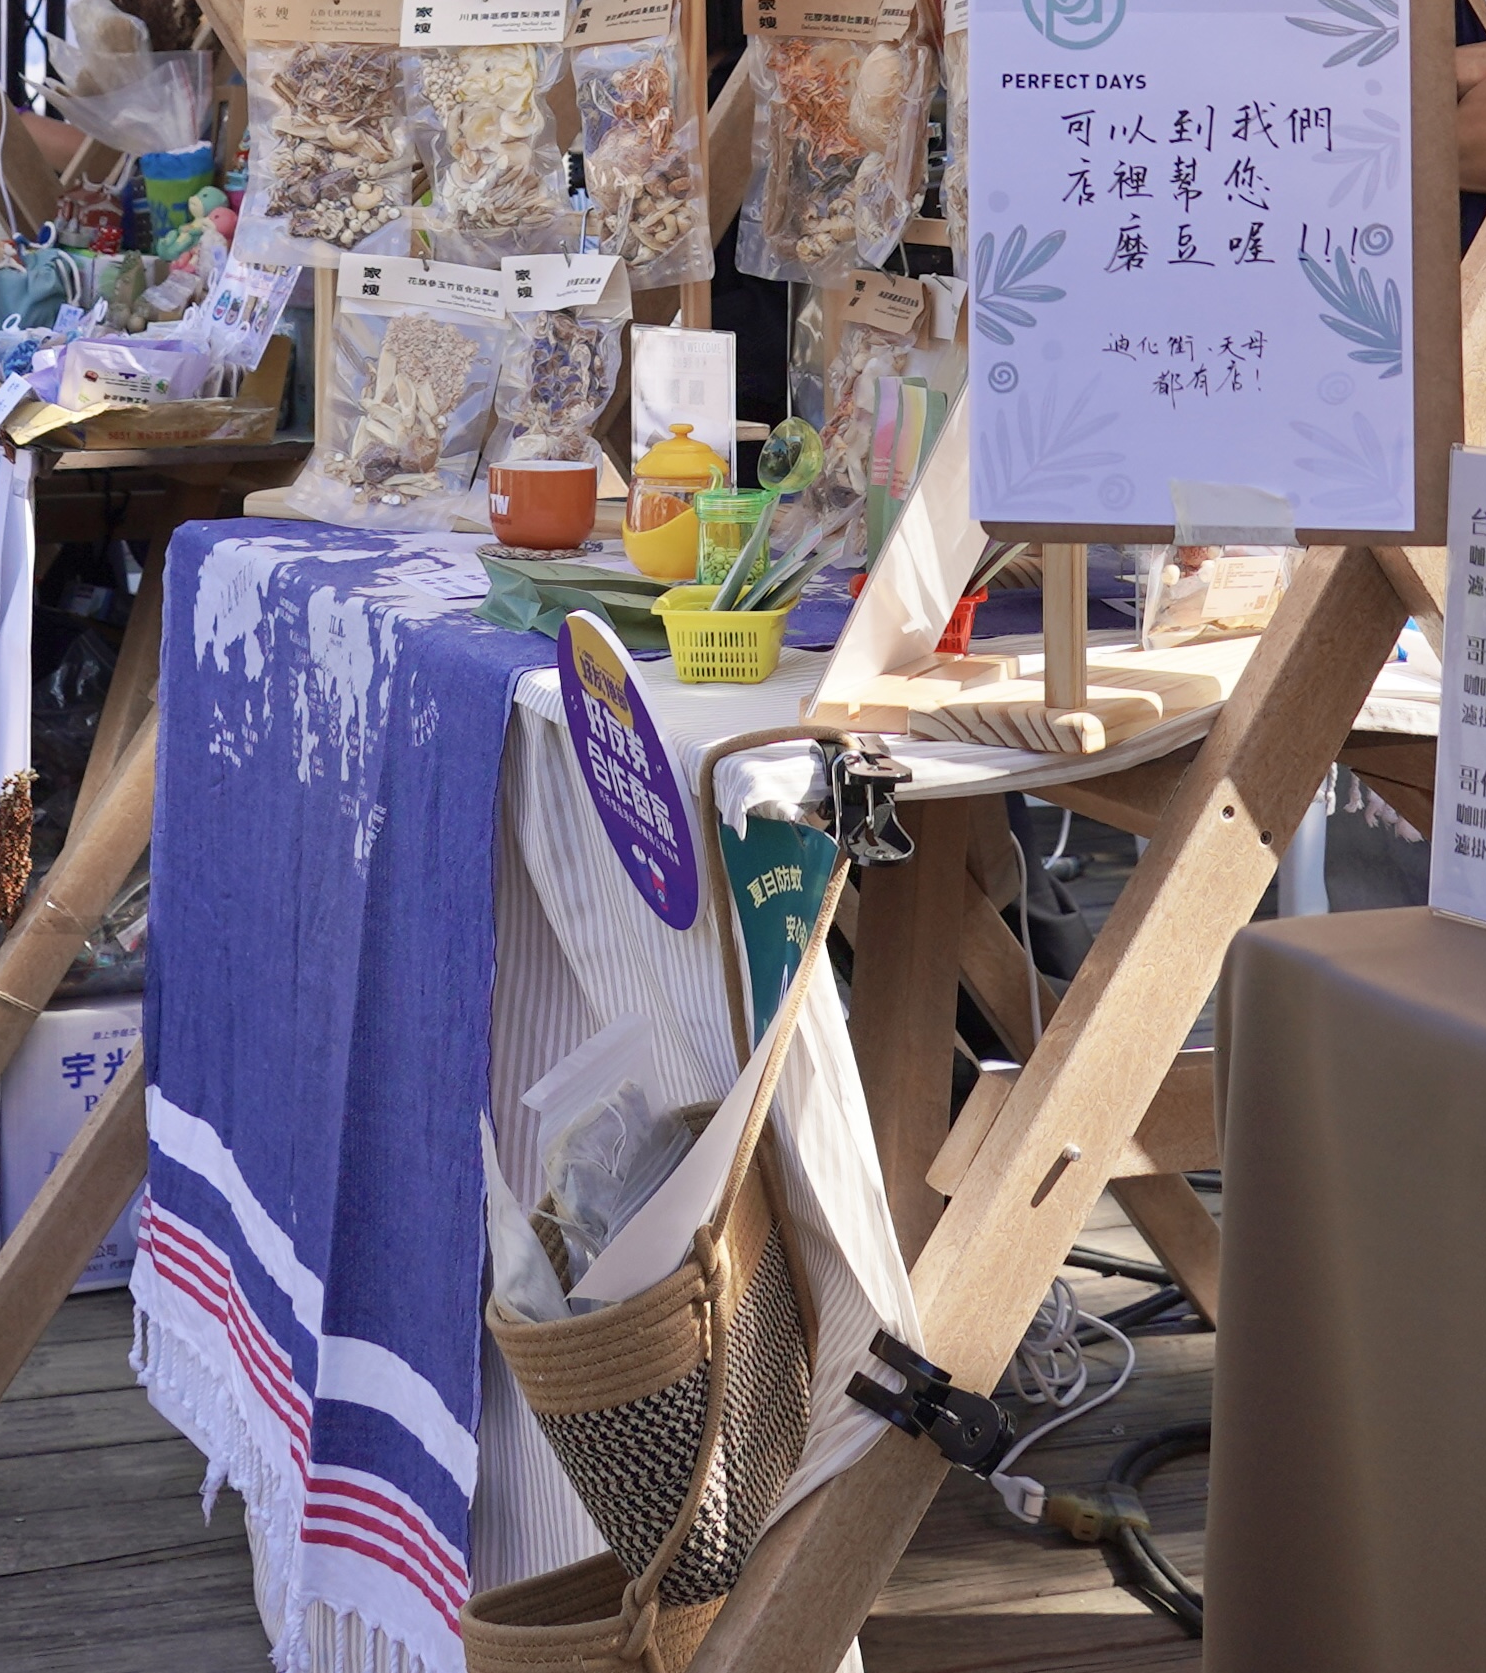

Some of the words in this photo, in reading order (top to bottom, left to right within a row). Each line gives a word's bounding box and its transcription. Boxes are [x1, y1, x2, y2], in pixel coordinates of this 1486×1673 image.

[252, 6, 289, 20] 家嫂
[414, 7, 433, 34] 家嫂
[1001, 73, 1090, 90] PERFECT
[1095, 73, 1147, 90] DAYS
[1060, 102, 1334, 152] 可以到我們
[1061, 157, 1271, 212] 店裡幫您
[362, 267, 382, 297] 家嫂
[515, 269, 534, 299] 家嫂
[586, 736, 678, 849] 合作商家
[747, 864, 804, 909] 夏日防蚊
